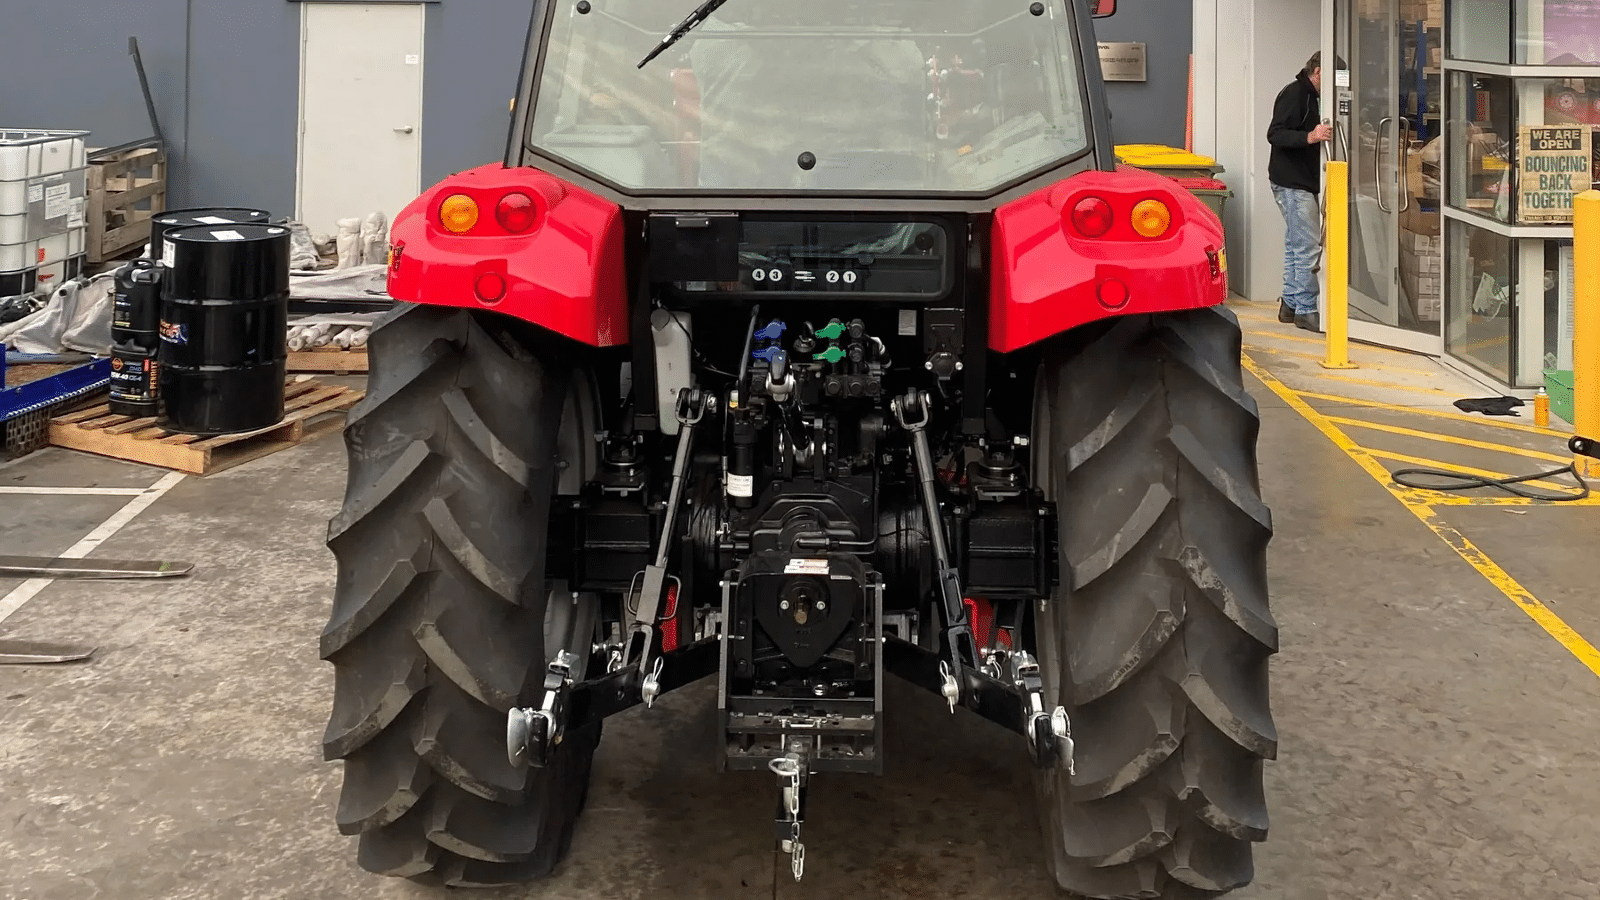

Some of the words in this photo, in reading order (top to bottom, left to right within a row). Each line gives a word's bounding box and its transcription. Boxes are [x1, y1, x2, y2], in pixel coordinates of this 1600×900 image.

[1532, 130, 1551, 140] WE
[1555, 130, 1580, 140] ARE
[1539, 140, 1573, 149] OPEN
[1525, 156, 1587, 172] BOUNCING
[1539, 174, 1572, 190] BACK
[1524, 192, 1573, 208] TOGETH
